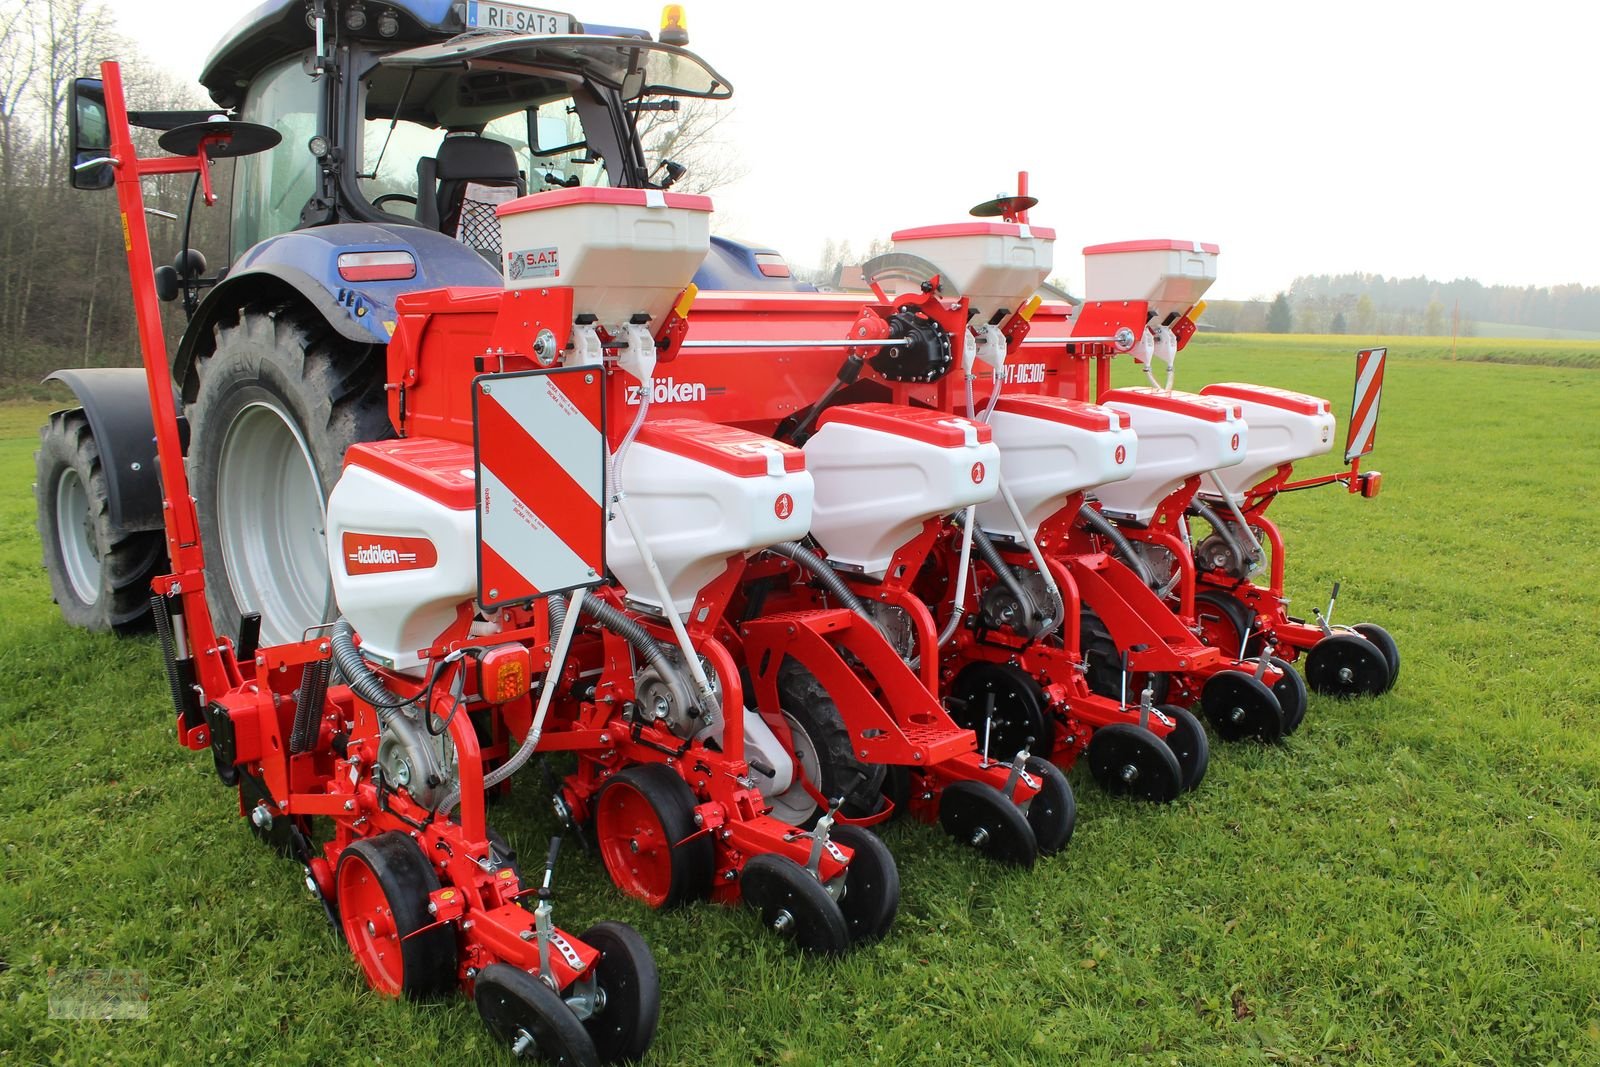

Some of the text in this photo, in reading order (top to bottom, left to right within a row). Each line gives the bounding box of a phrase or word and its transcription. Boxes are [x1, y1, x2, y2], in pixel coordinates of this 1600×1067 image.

[489, 7, 557, 34] RI SAT 3
[526, 251, 558, 265] S.A.T.
[357, 544, 400, 564] özdöken
